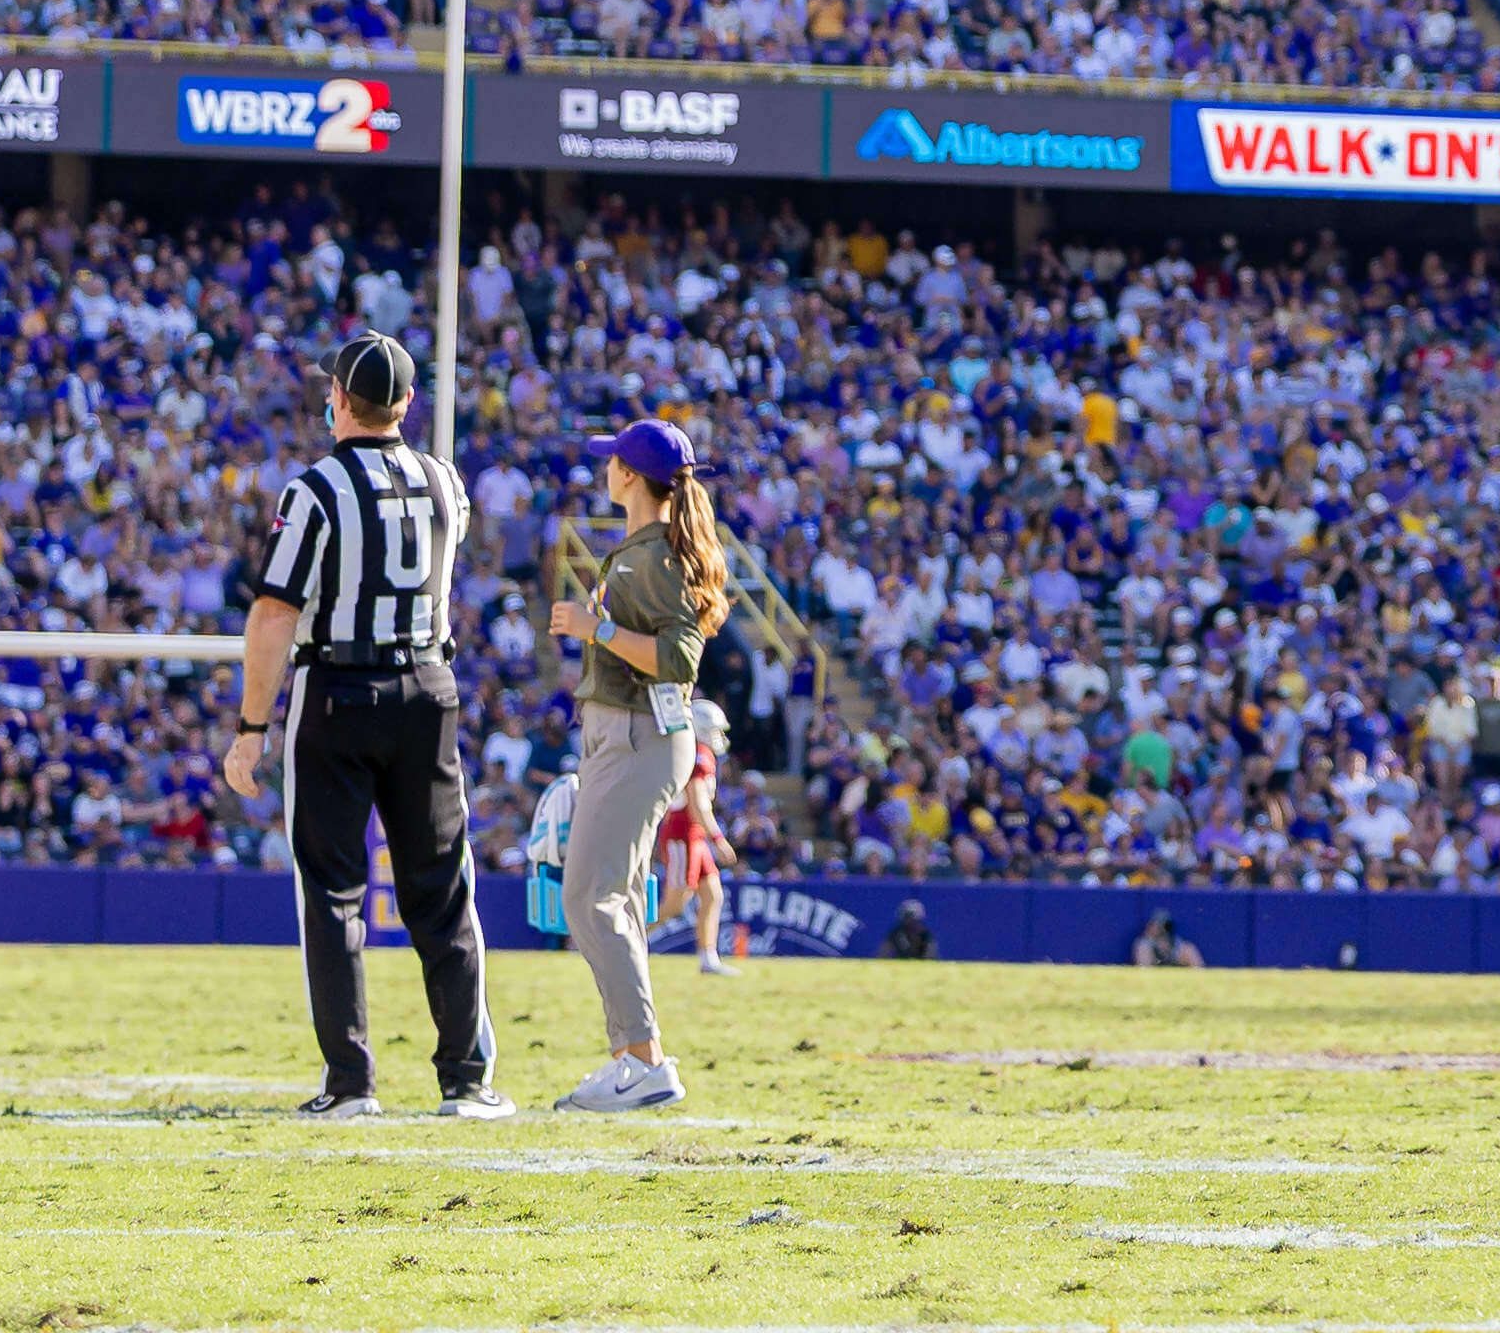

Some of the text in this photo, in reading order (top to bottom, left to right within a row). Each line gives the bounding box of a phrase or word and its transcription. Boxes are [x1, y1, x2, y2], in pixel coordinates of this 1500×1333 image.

[185, 77, 373, 154] WBRZ 2
[619, 89, 741, 135] BASF
[558, 132, 740, 166] We create chemistry
[934, 120, 1142, 172] Albertsons
[376, 496, 435, 589] U
[737, 885, 864, 951] PLATE
